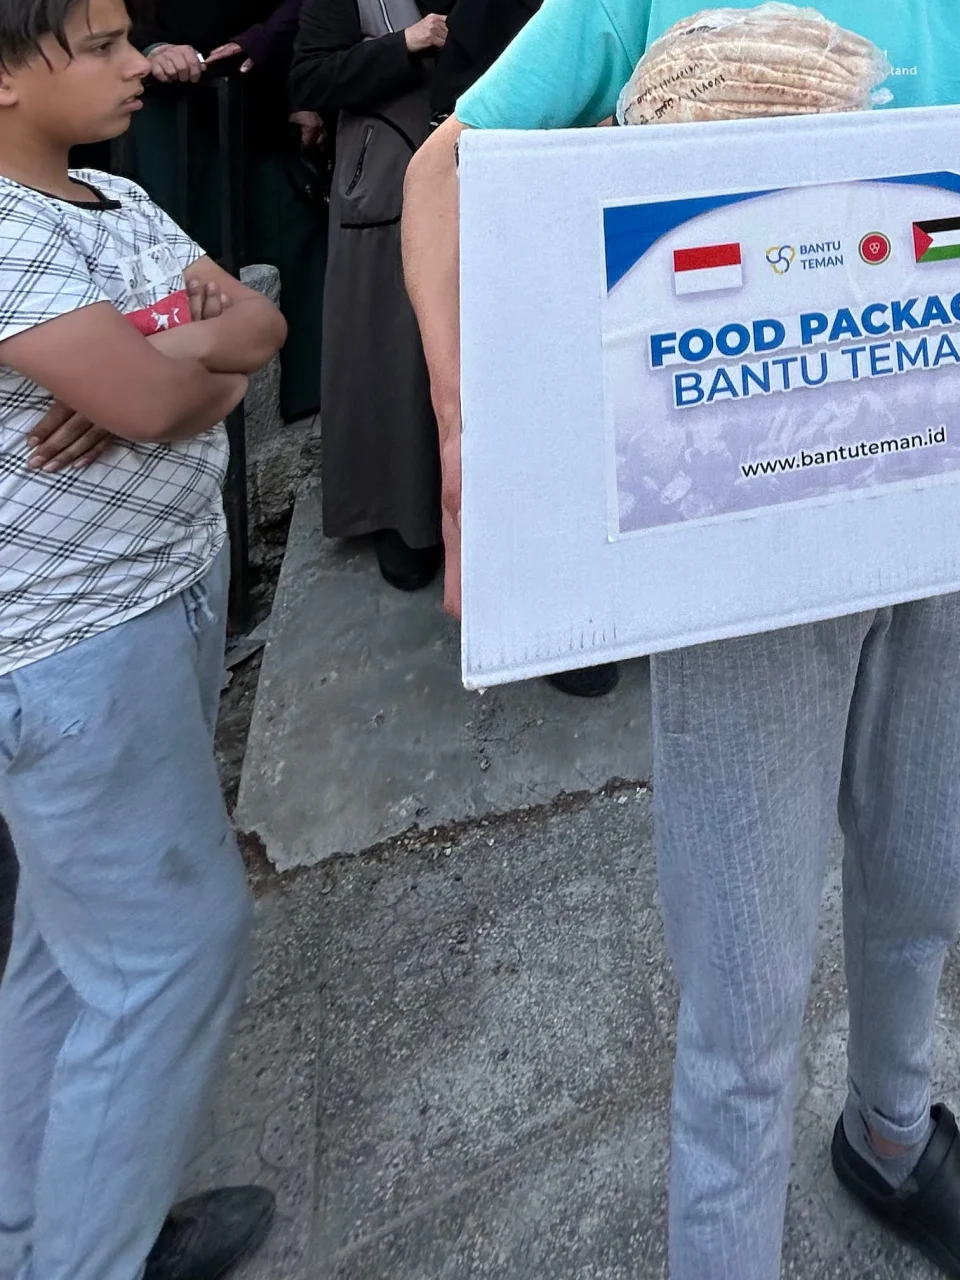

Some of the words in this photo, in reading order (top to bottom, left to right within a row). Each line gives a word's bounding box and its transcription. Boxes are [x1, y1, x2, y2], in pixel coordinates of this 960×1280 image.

[800, 240, 841, 255] BANTU
[800, 255, 844, 270] TEMAN
[650, 319, 786, 367] FOOD
[674, 352, 829, 407] BANTU
[742, 426, 946, 478] www.bantuteman.id
